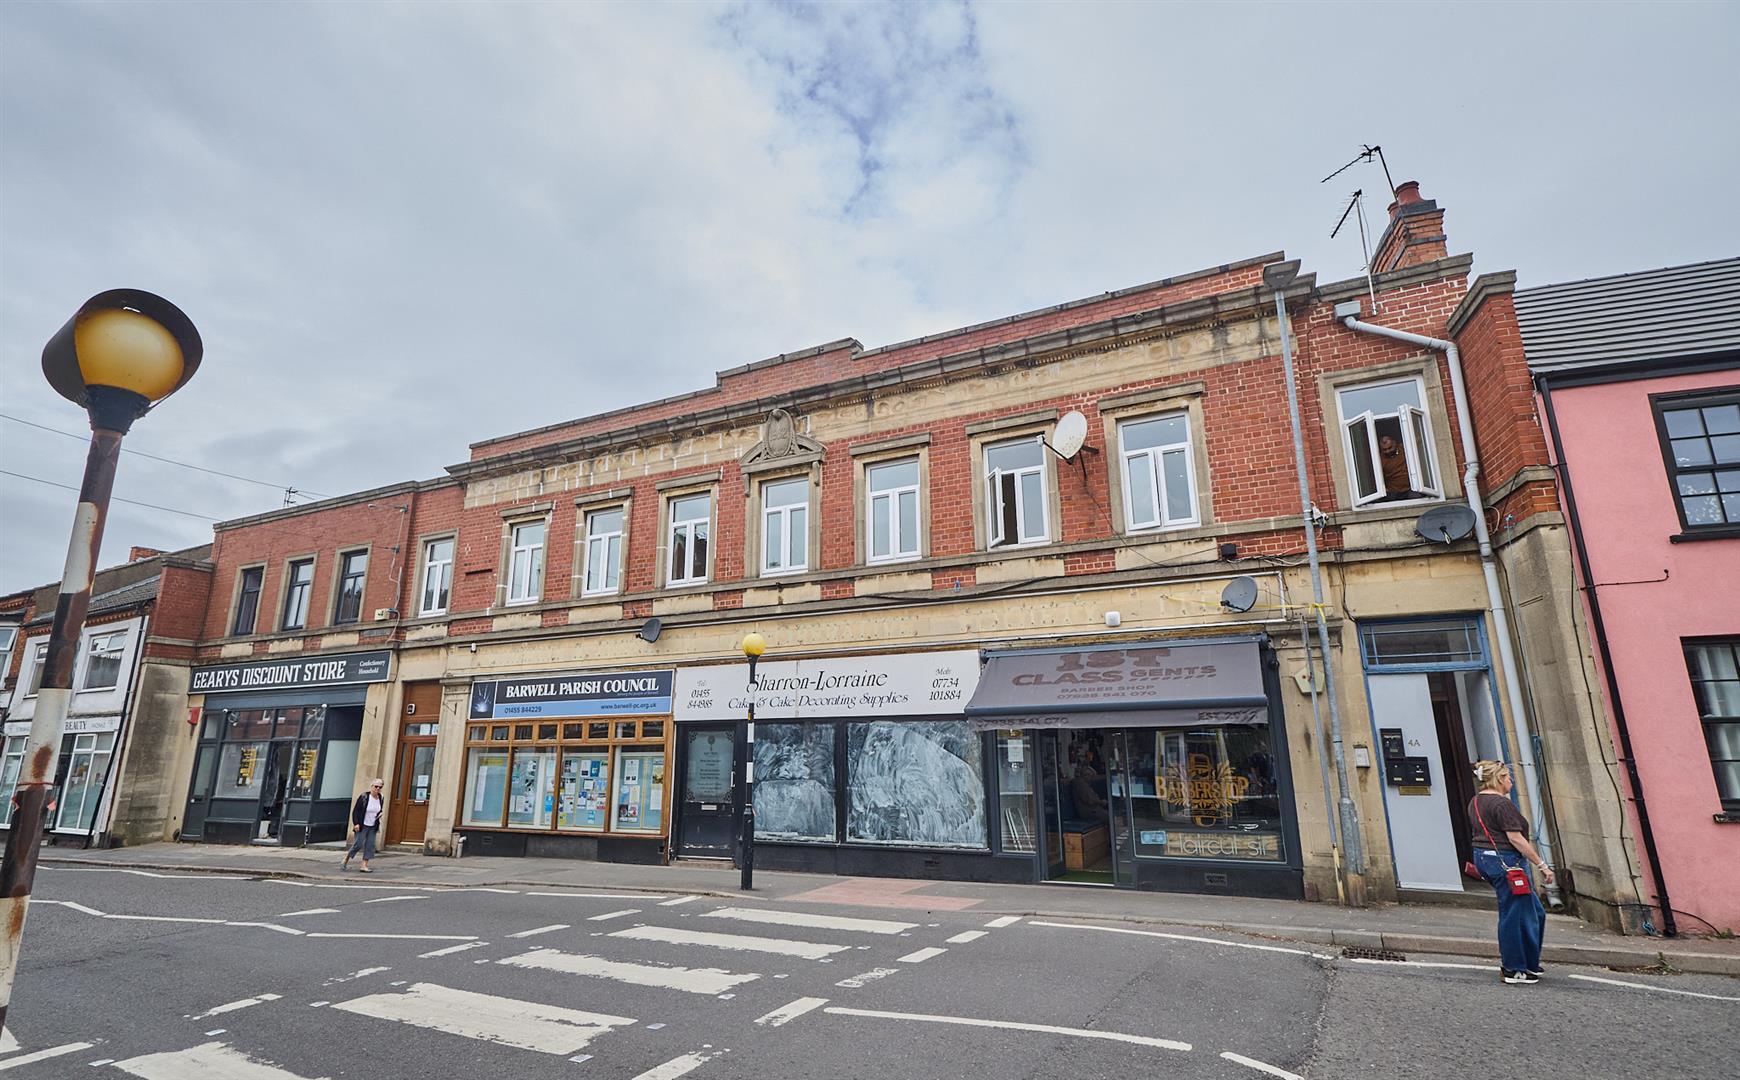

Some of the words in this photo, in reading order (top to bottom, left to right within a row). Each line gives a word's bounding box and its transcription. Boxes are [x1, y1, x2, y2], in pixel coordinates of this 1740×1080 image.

[193, 669, 239, 688] GEARYS
[241, 664, 302, 686] DISCOUNT
[303, 660, 347, 682] STORE
[932, 678, 959, 689] 07734
[1012, 670, 1124, 686] CLASS
[1130, 665, 1216, 678] GENTS
[506, 683, 557, 698] BARWELL
[559, 680, 601, 695] PARISH
[603, 678, 659, 693] COUNCIL
[691, 689, 711, 698] 01455
[929, 690, 961, 701] 101884
[769, 696, 795, 708] Cake
[798, 693, 856, 709] Decorating
[859, 690, 909, 708] Supplies
[504, 706, 520, 714] 01455
[521, 705, 542, 713] 844229
[64, 720, 87, 731] BEAUTY
[1155, 775, 1249, 800] BARBERSHOP
[1166, 832, 1238, 855] Haircut
